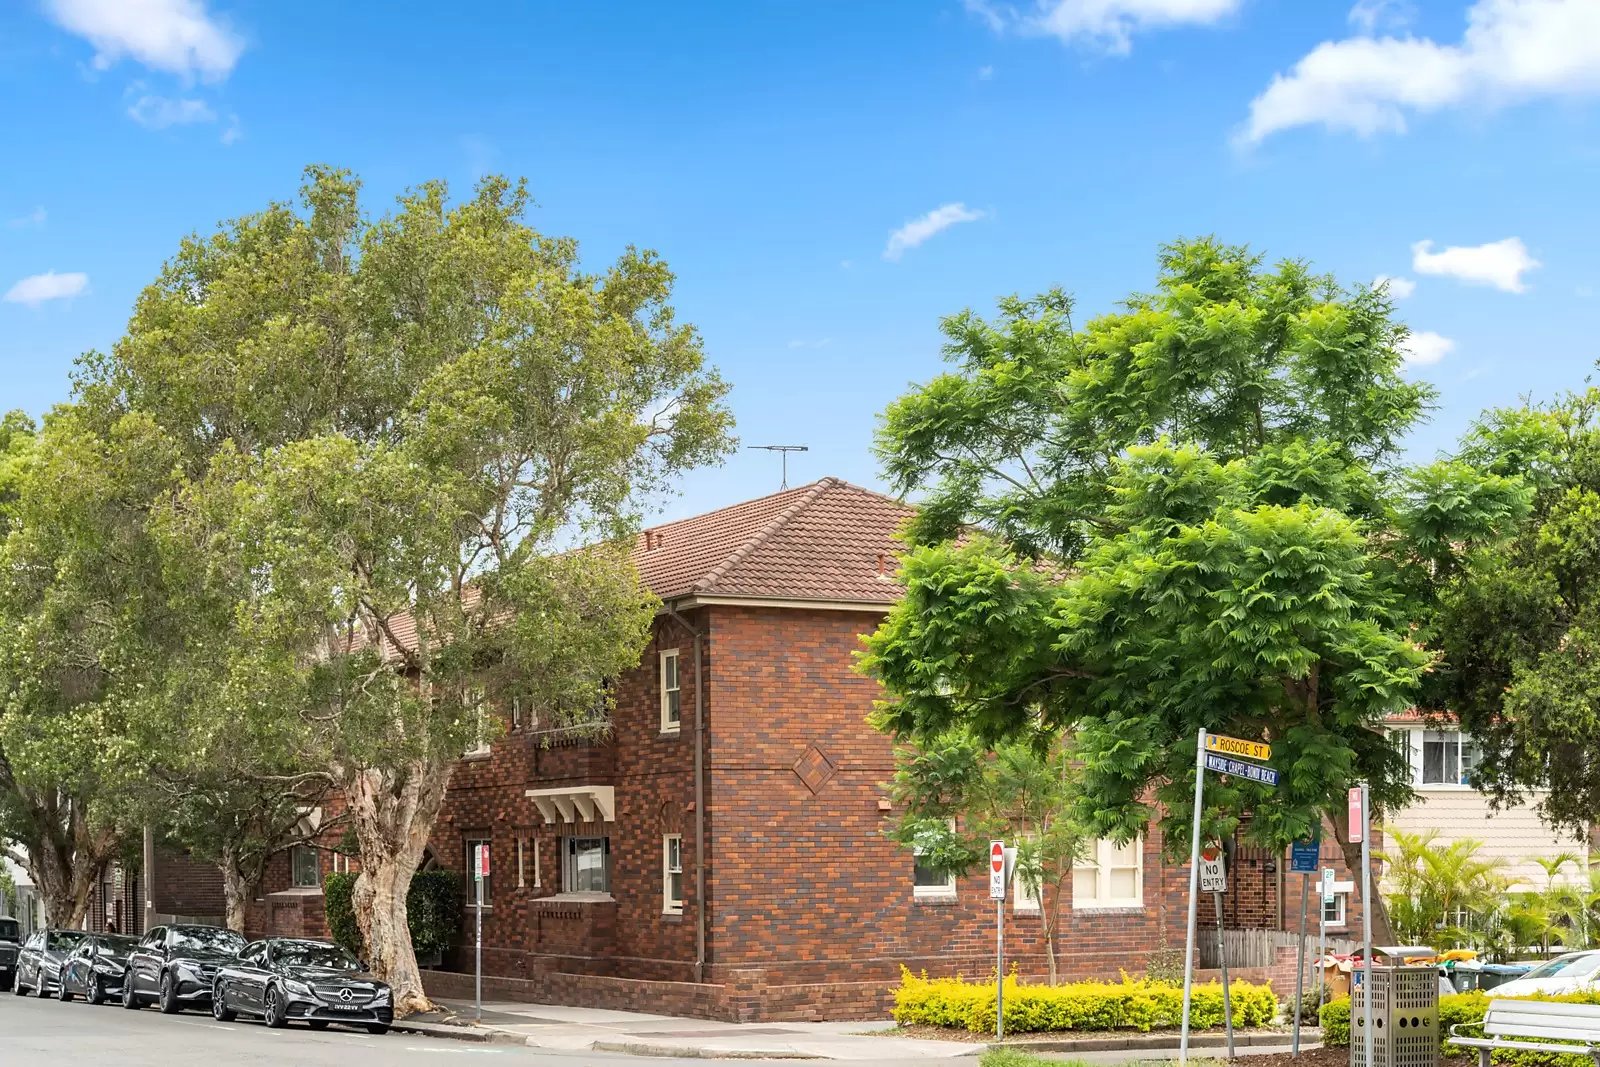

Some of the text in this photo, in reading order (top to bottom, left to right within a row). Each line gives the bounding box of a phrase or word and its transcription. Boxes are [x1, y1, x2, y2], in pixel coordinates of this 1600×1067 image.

[1220, 739, 1264, 757] ROSCOE ST
[1208, 755, 1227, 771] WAYSIDE
[1261, 769, 1276, 784] BEACH
[1205, 864, 1219, 875] NO
[1325, 870, 1334, 879] 2P
[993, 875, 1001, 885] NO
[1202, 877, 1224, 887] ENTRY
[991, 886, 1003, 895] ENTRY
